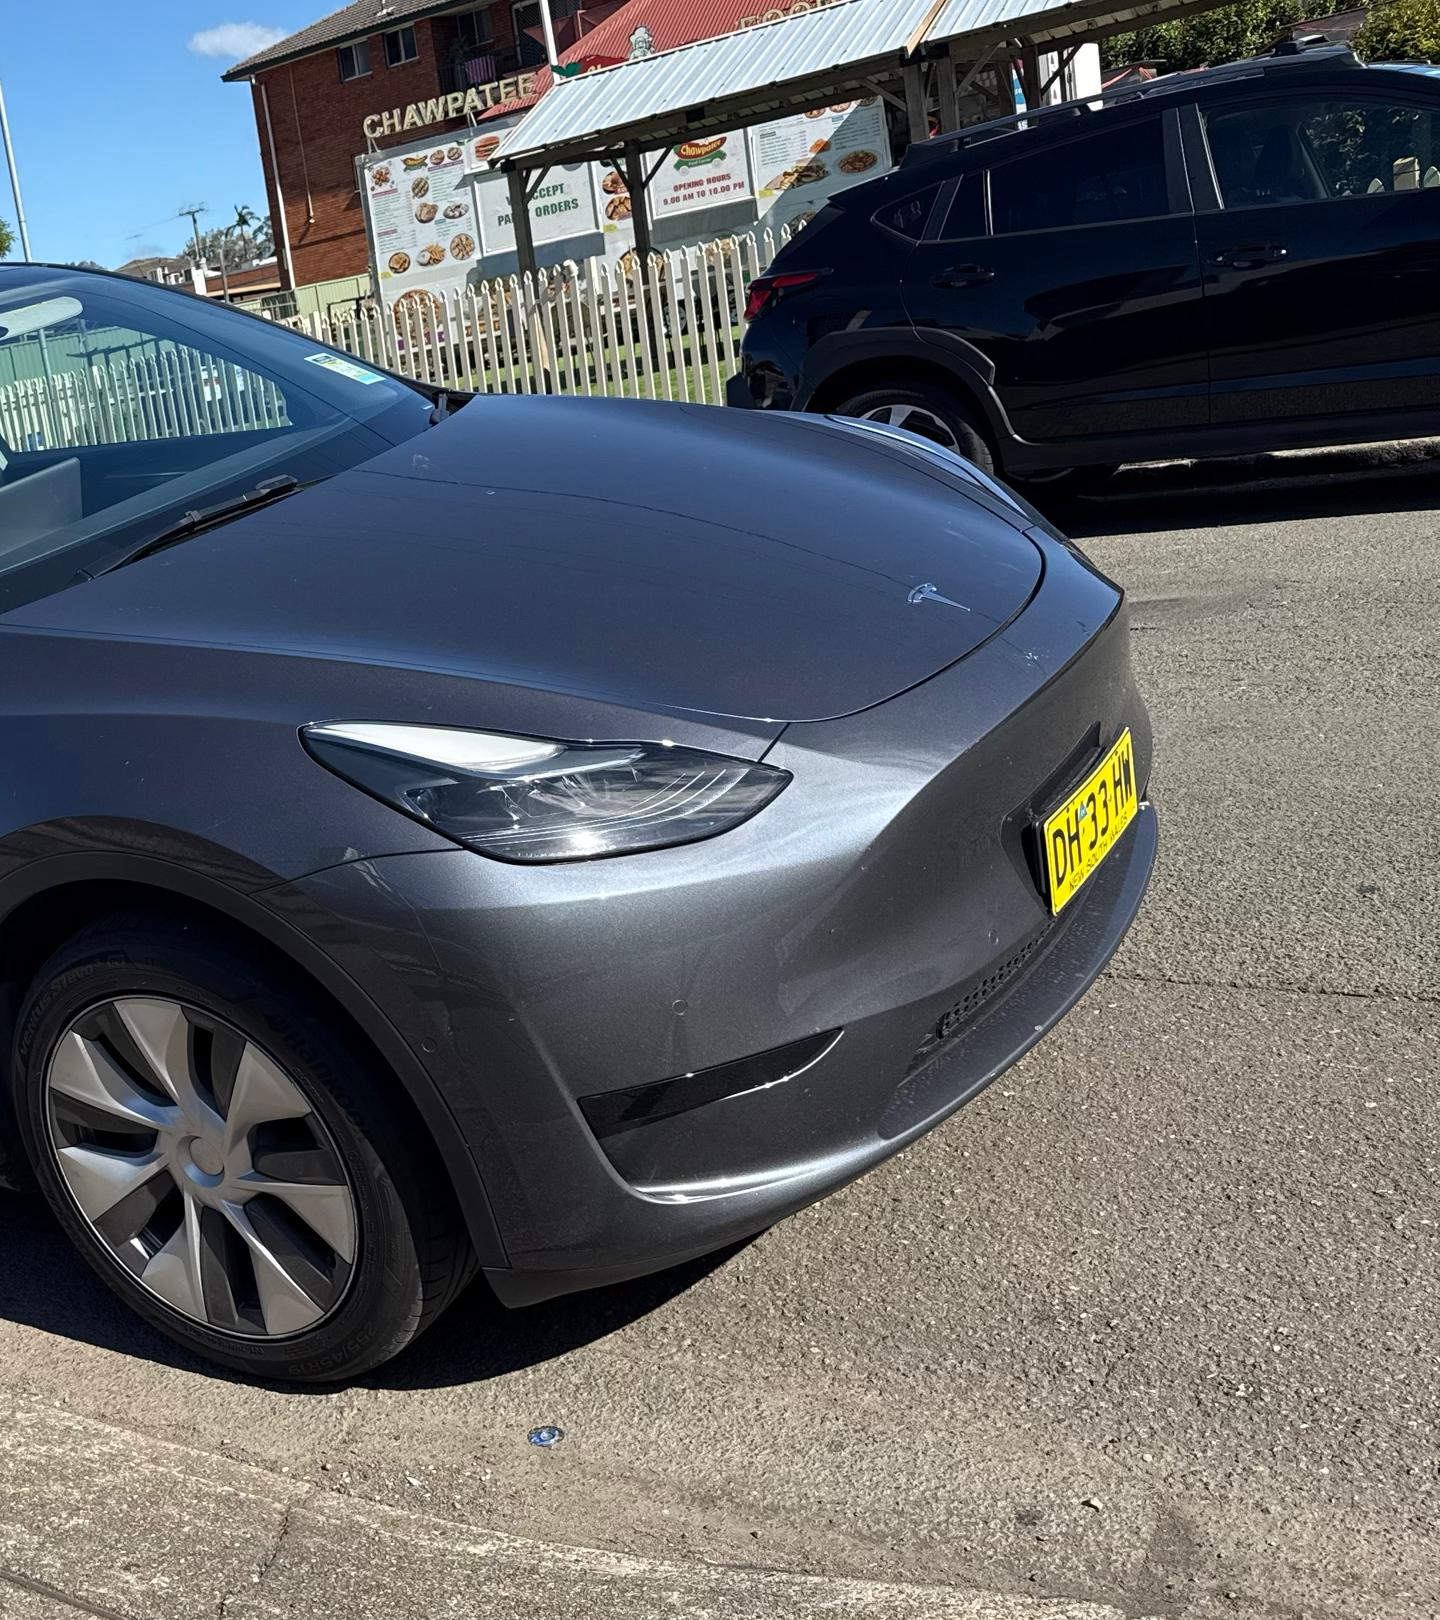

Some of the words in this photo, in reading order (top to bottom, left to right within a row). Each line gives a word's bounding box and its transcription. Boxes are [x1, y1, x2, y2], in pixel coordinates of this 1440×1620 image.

[363, 71, 537, 138] CHAWPATEE
[673, 179, 704, 192] OPENING
[706, 173, 732, 185] HOURS
[682, 192, 695, 201] AM
[696, 190, 706, 198] TO
[708, 184, 731, 195] 10.00
[733, 181, 745, 190] PM
[535, 198, 579, 218] ORDERS
[1086, 838, 1108, 870] SOUTH
